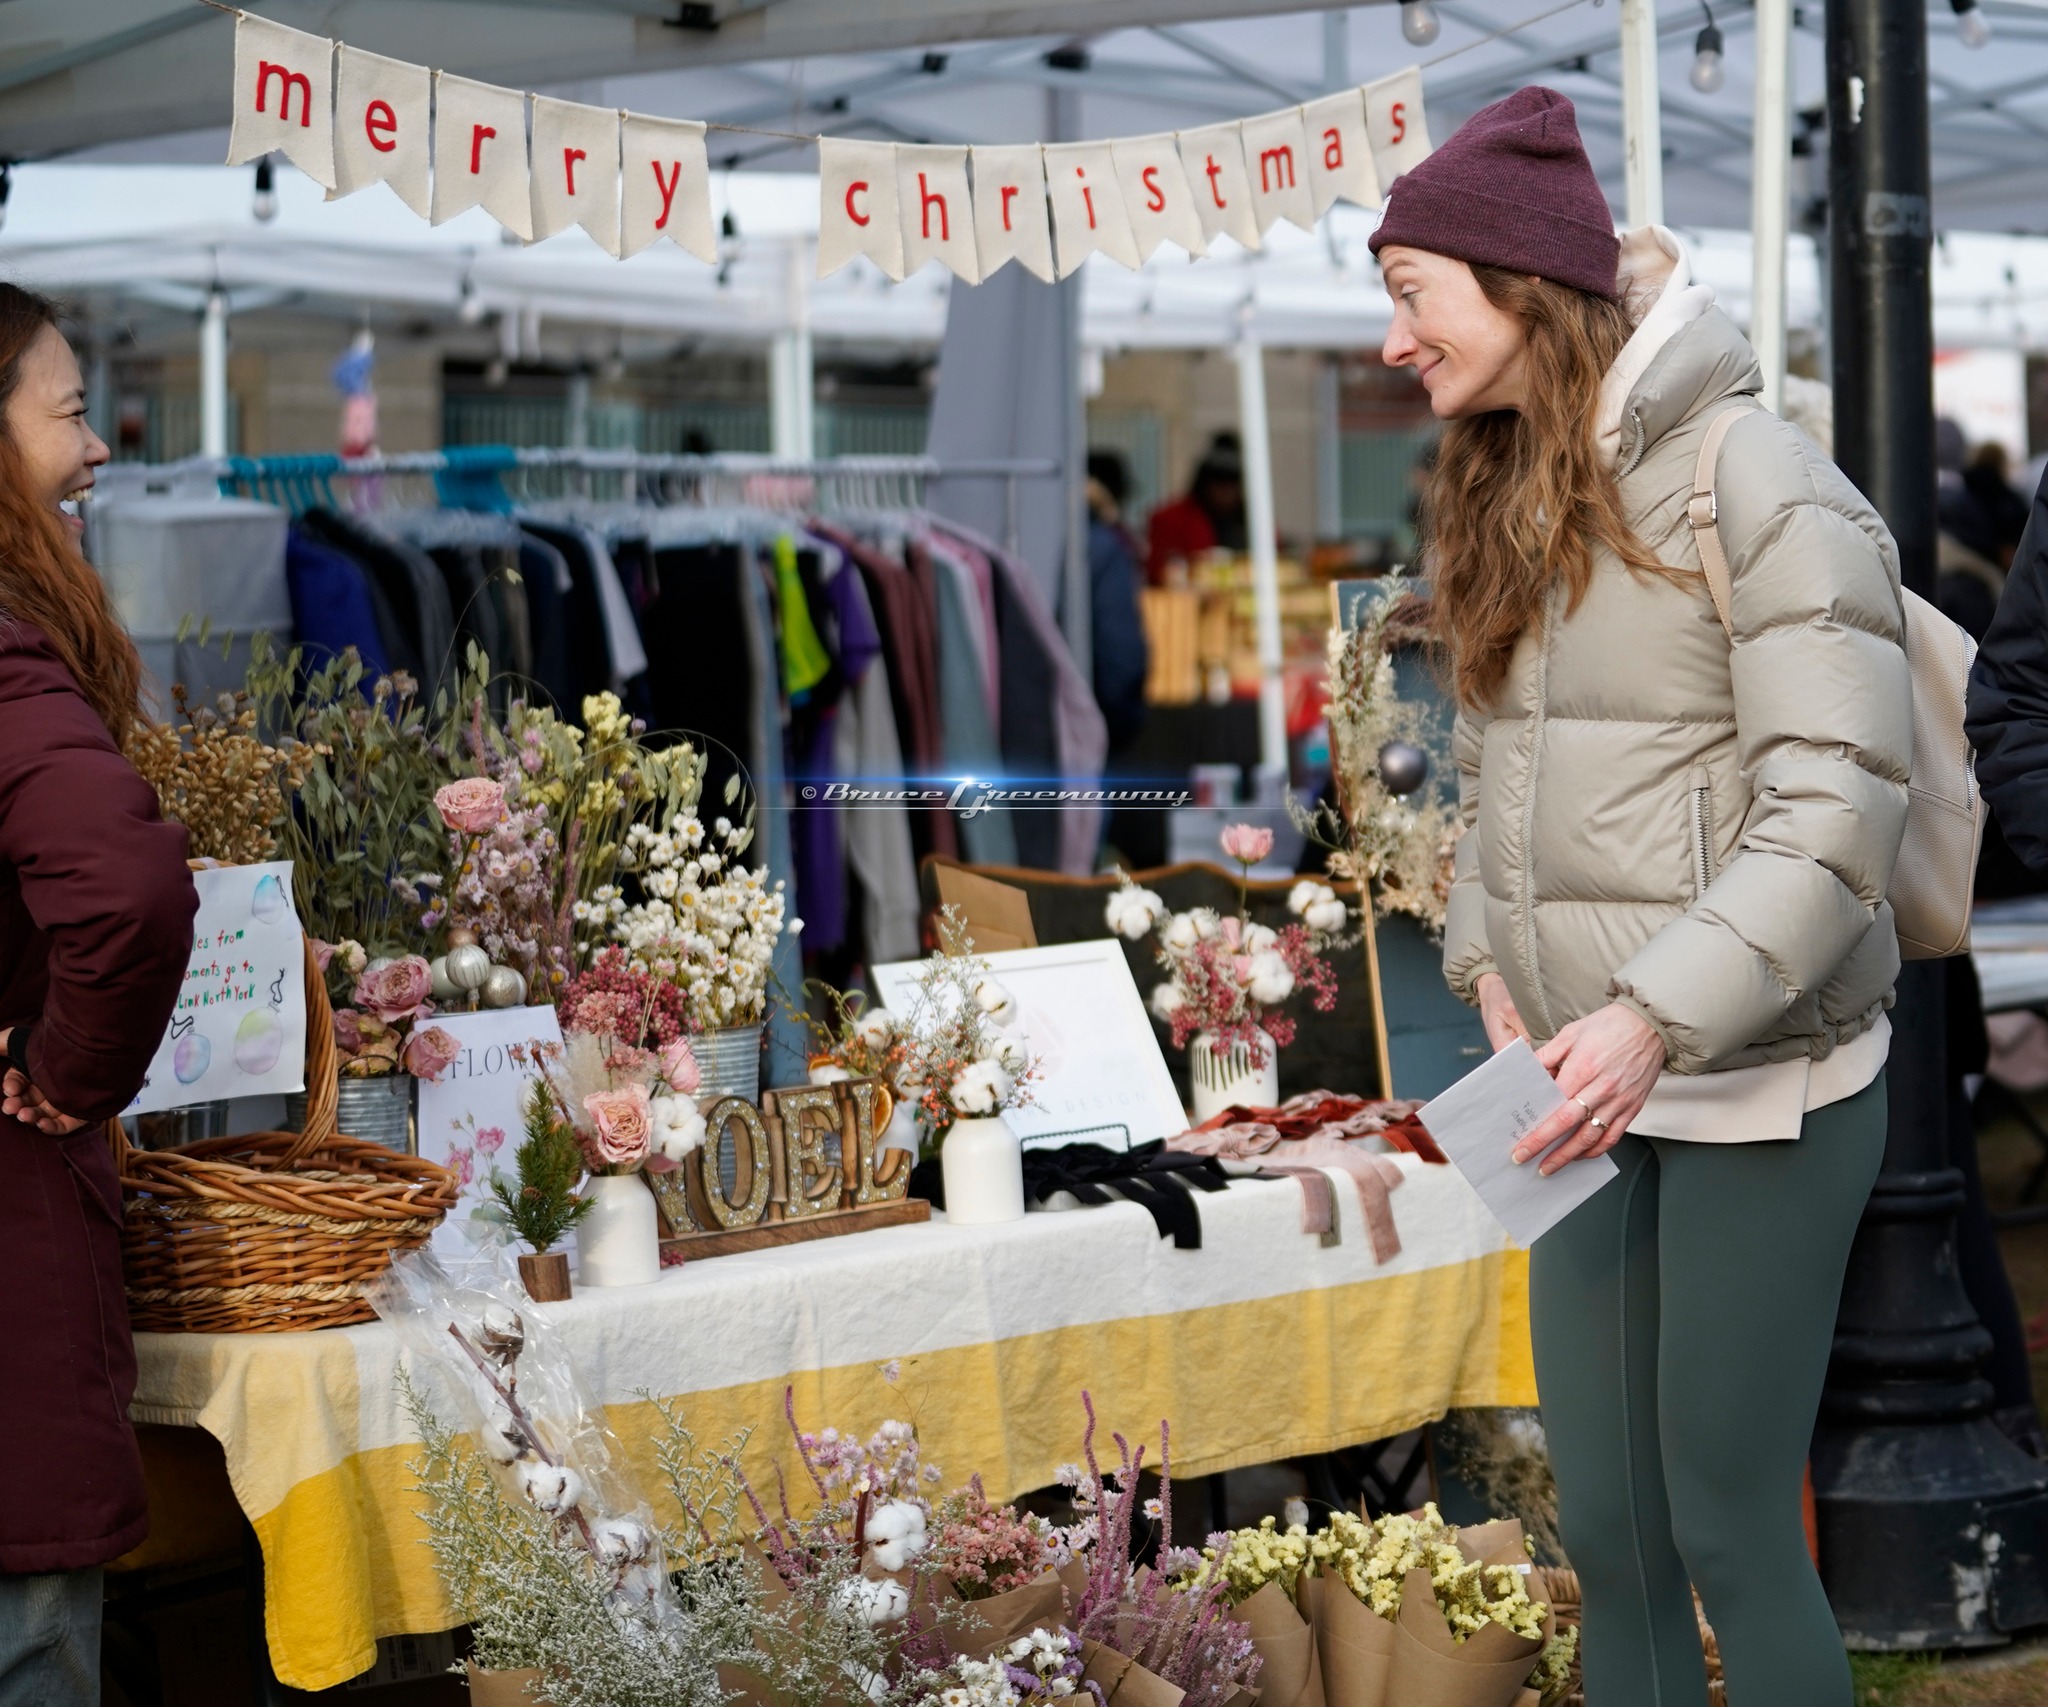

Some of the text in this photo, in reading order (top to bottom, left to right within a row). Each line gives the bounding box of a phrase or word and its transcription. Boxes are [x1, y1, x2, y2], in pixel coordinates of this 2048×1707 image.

[255, 59, 1407, 241] merry christmas
[193, 929, 245, 952] les from
[184, 960, 254, 984] aments go to
[203, 985, 232, 1006] North
